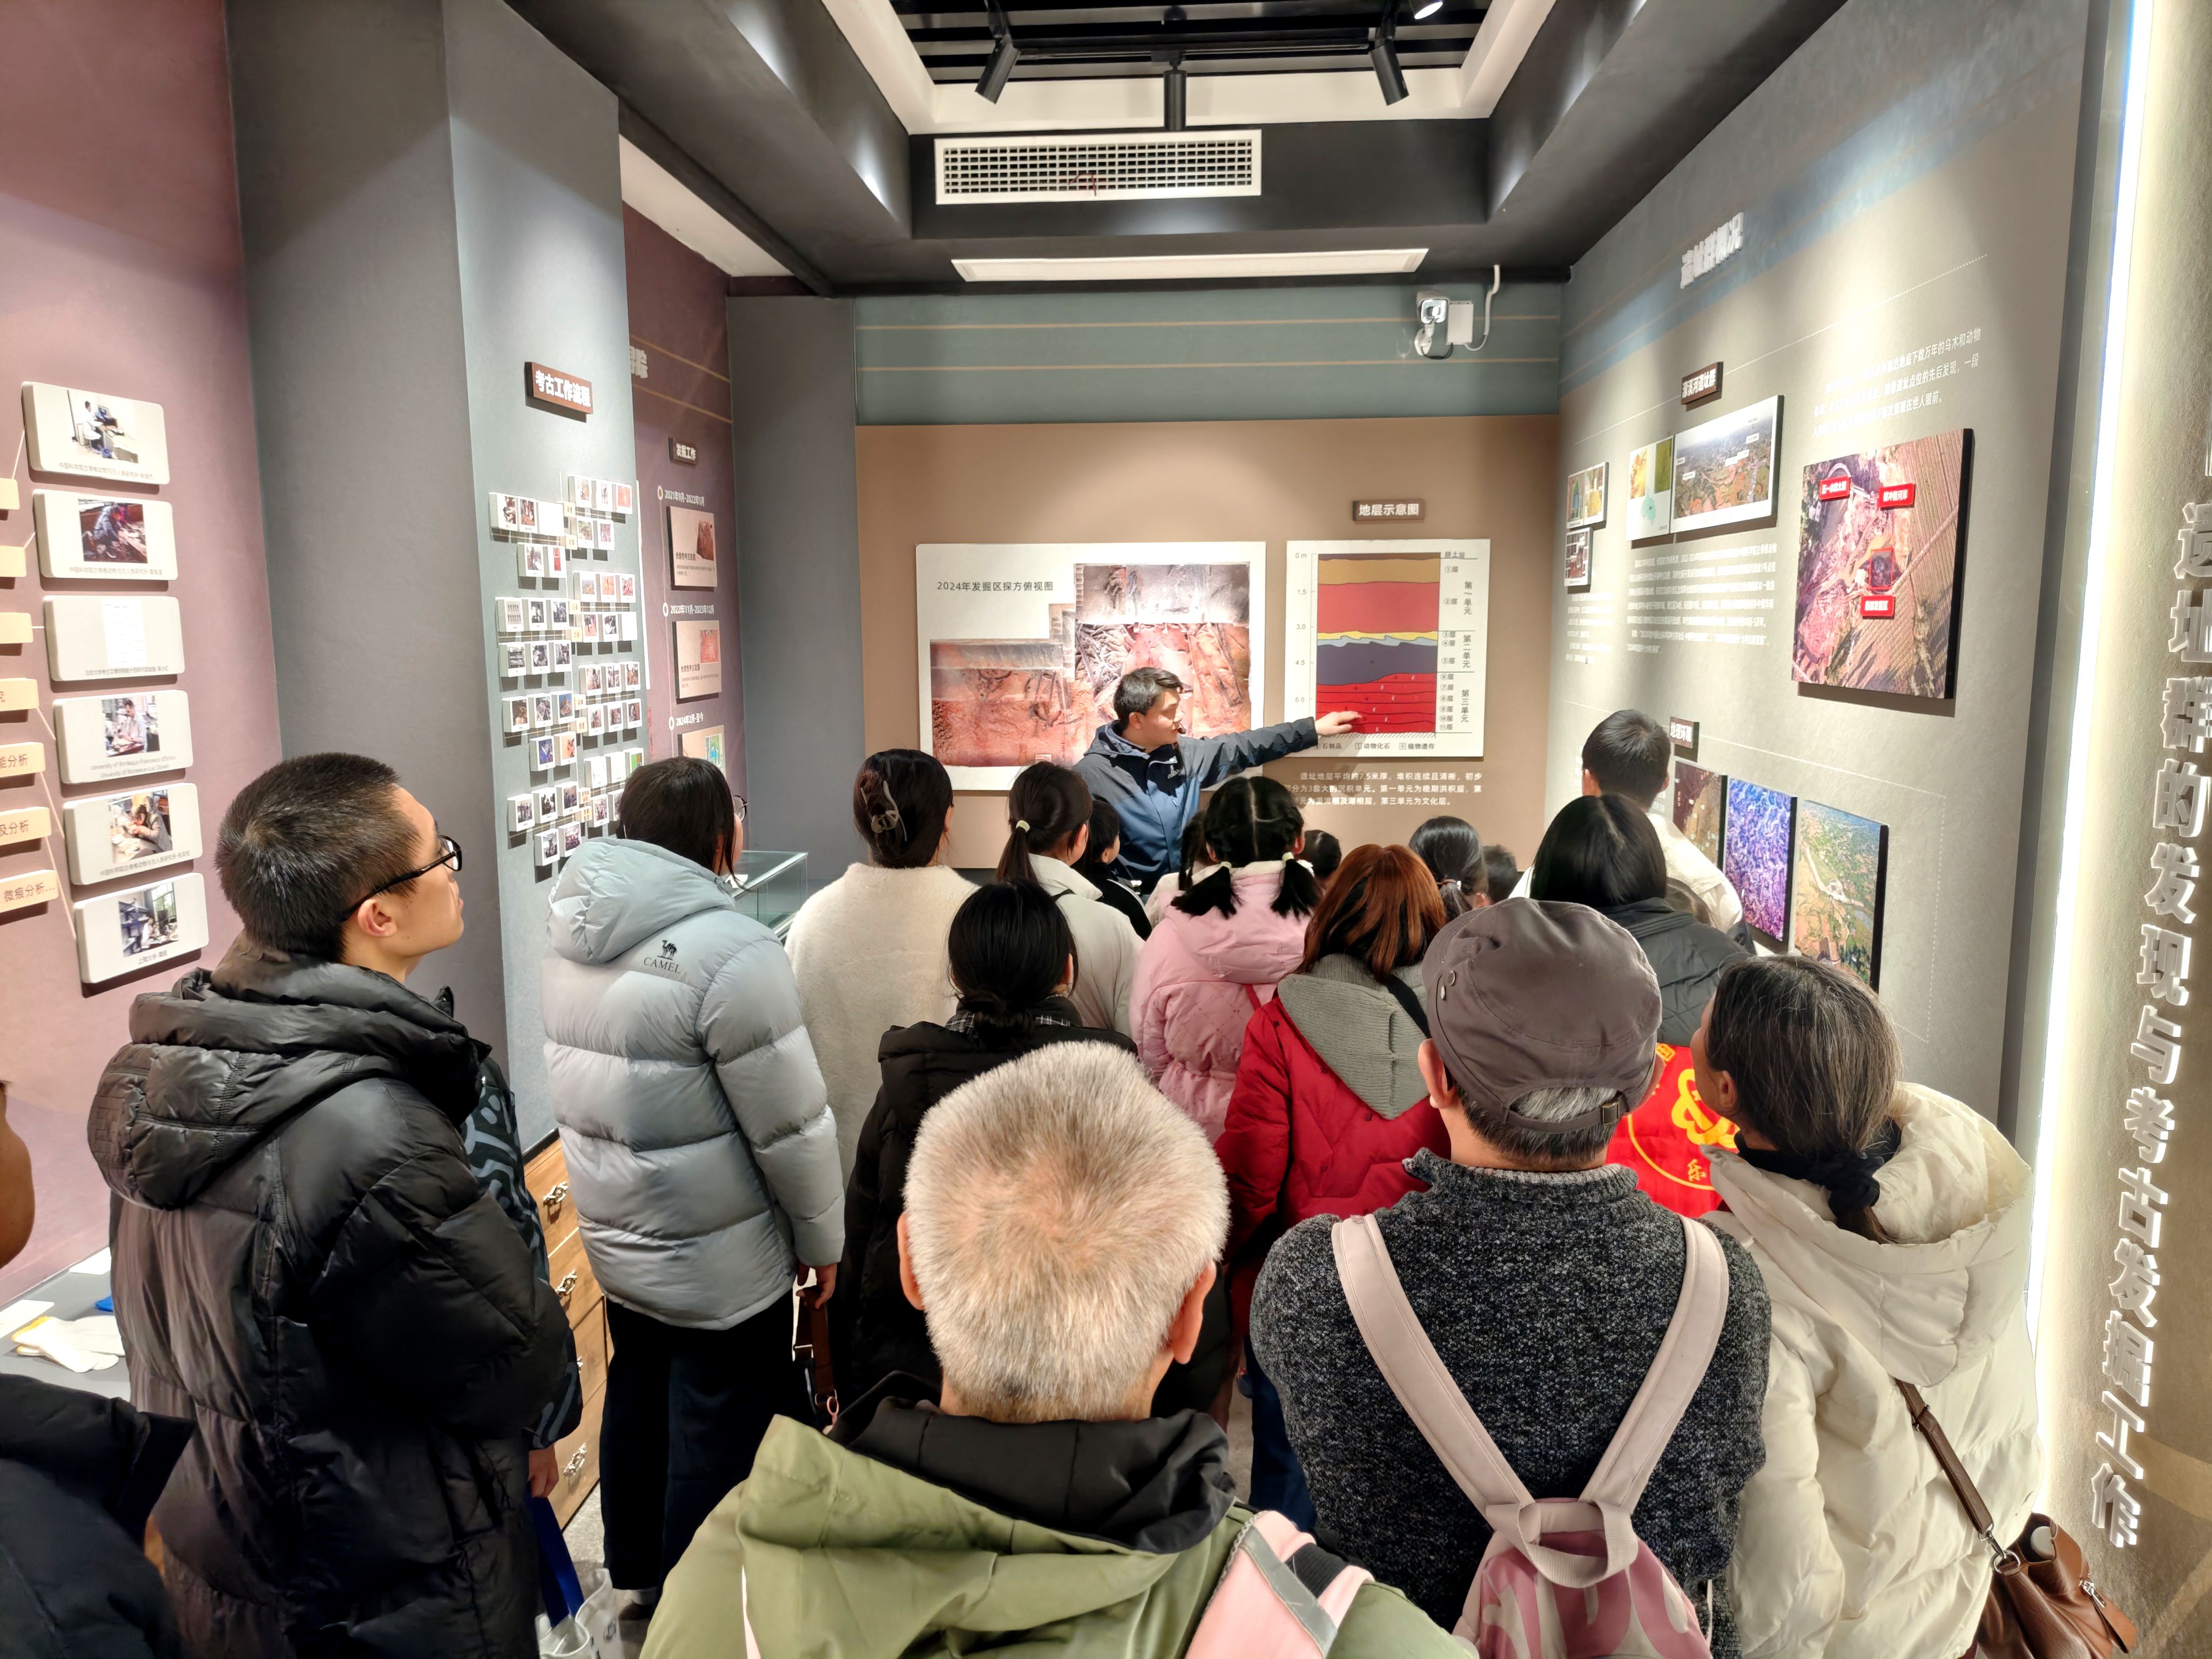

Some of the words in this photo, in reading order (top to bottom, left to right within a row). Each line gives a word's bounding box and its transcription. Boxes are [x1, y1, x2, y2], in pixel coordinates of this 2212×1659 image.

[535, 370, 591, 407] 考古工作流程
[676, 443, 696, 461] 发掘工作
[1359, 503, 1419, 516] 地层示意图
[937, 581, 1053, 592] 2024年发掘区探方俯视图
[1464, 581, 1473, 615] 第一单元
[1462, 635, 1472, 669] 第二单元
[1461, 689, 1470, 723] 第三单元
[644, 956, 680, 974] CAMEL
[2090, 404, 2212, 1548] 遗址群的发现与考古发掘工作
